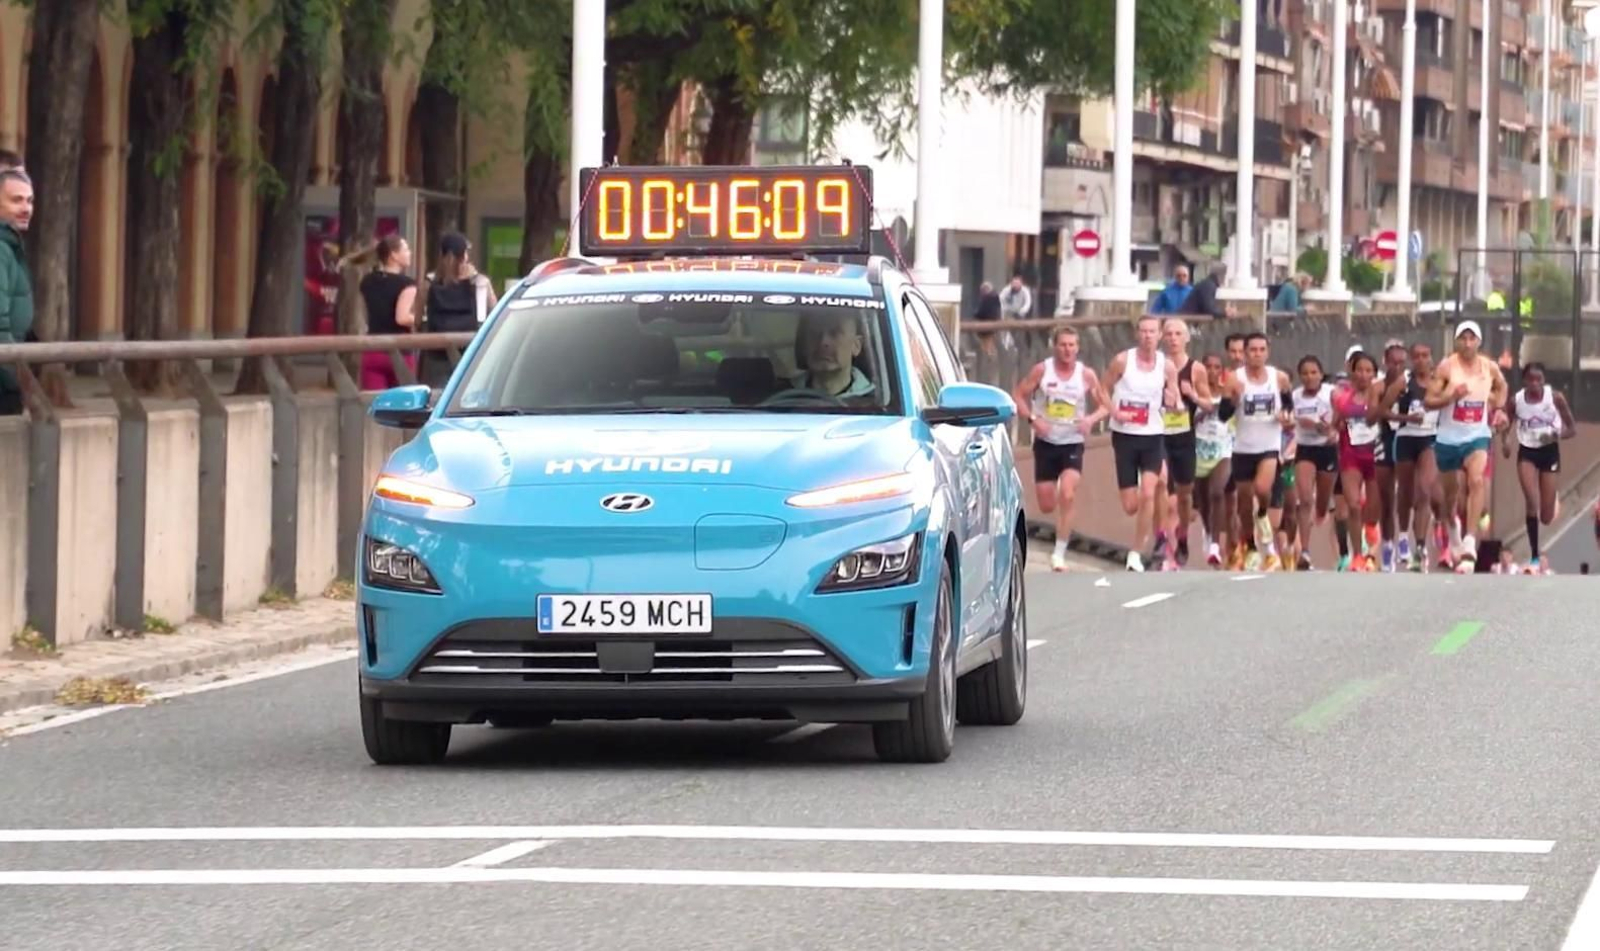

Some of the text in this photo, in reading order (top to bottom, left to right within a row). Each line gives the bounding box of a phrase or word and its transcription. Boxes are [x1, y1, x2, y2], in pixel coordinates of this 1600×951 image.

[598, 179, 850, 240] 00:46:09
[542, 294, 626, 306] HYUNDAI
[668, 293, 754, 303] HYUNDAI
[801, 296, 885, 309] HYUNDAI
[545, 457, 731, 474] HYUNDAI
[560, 600, 704, 627] 2459 MCH
